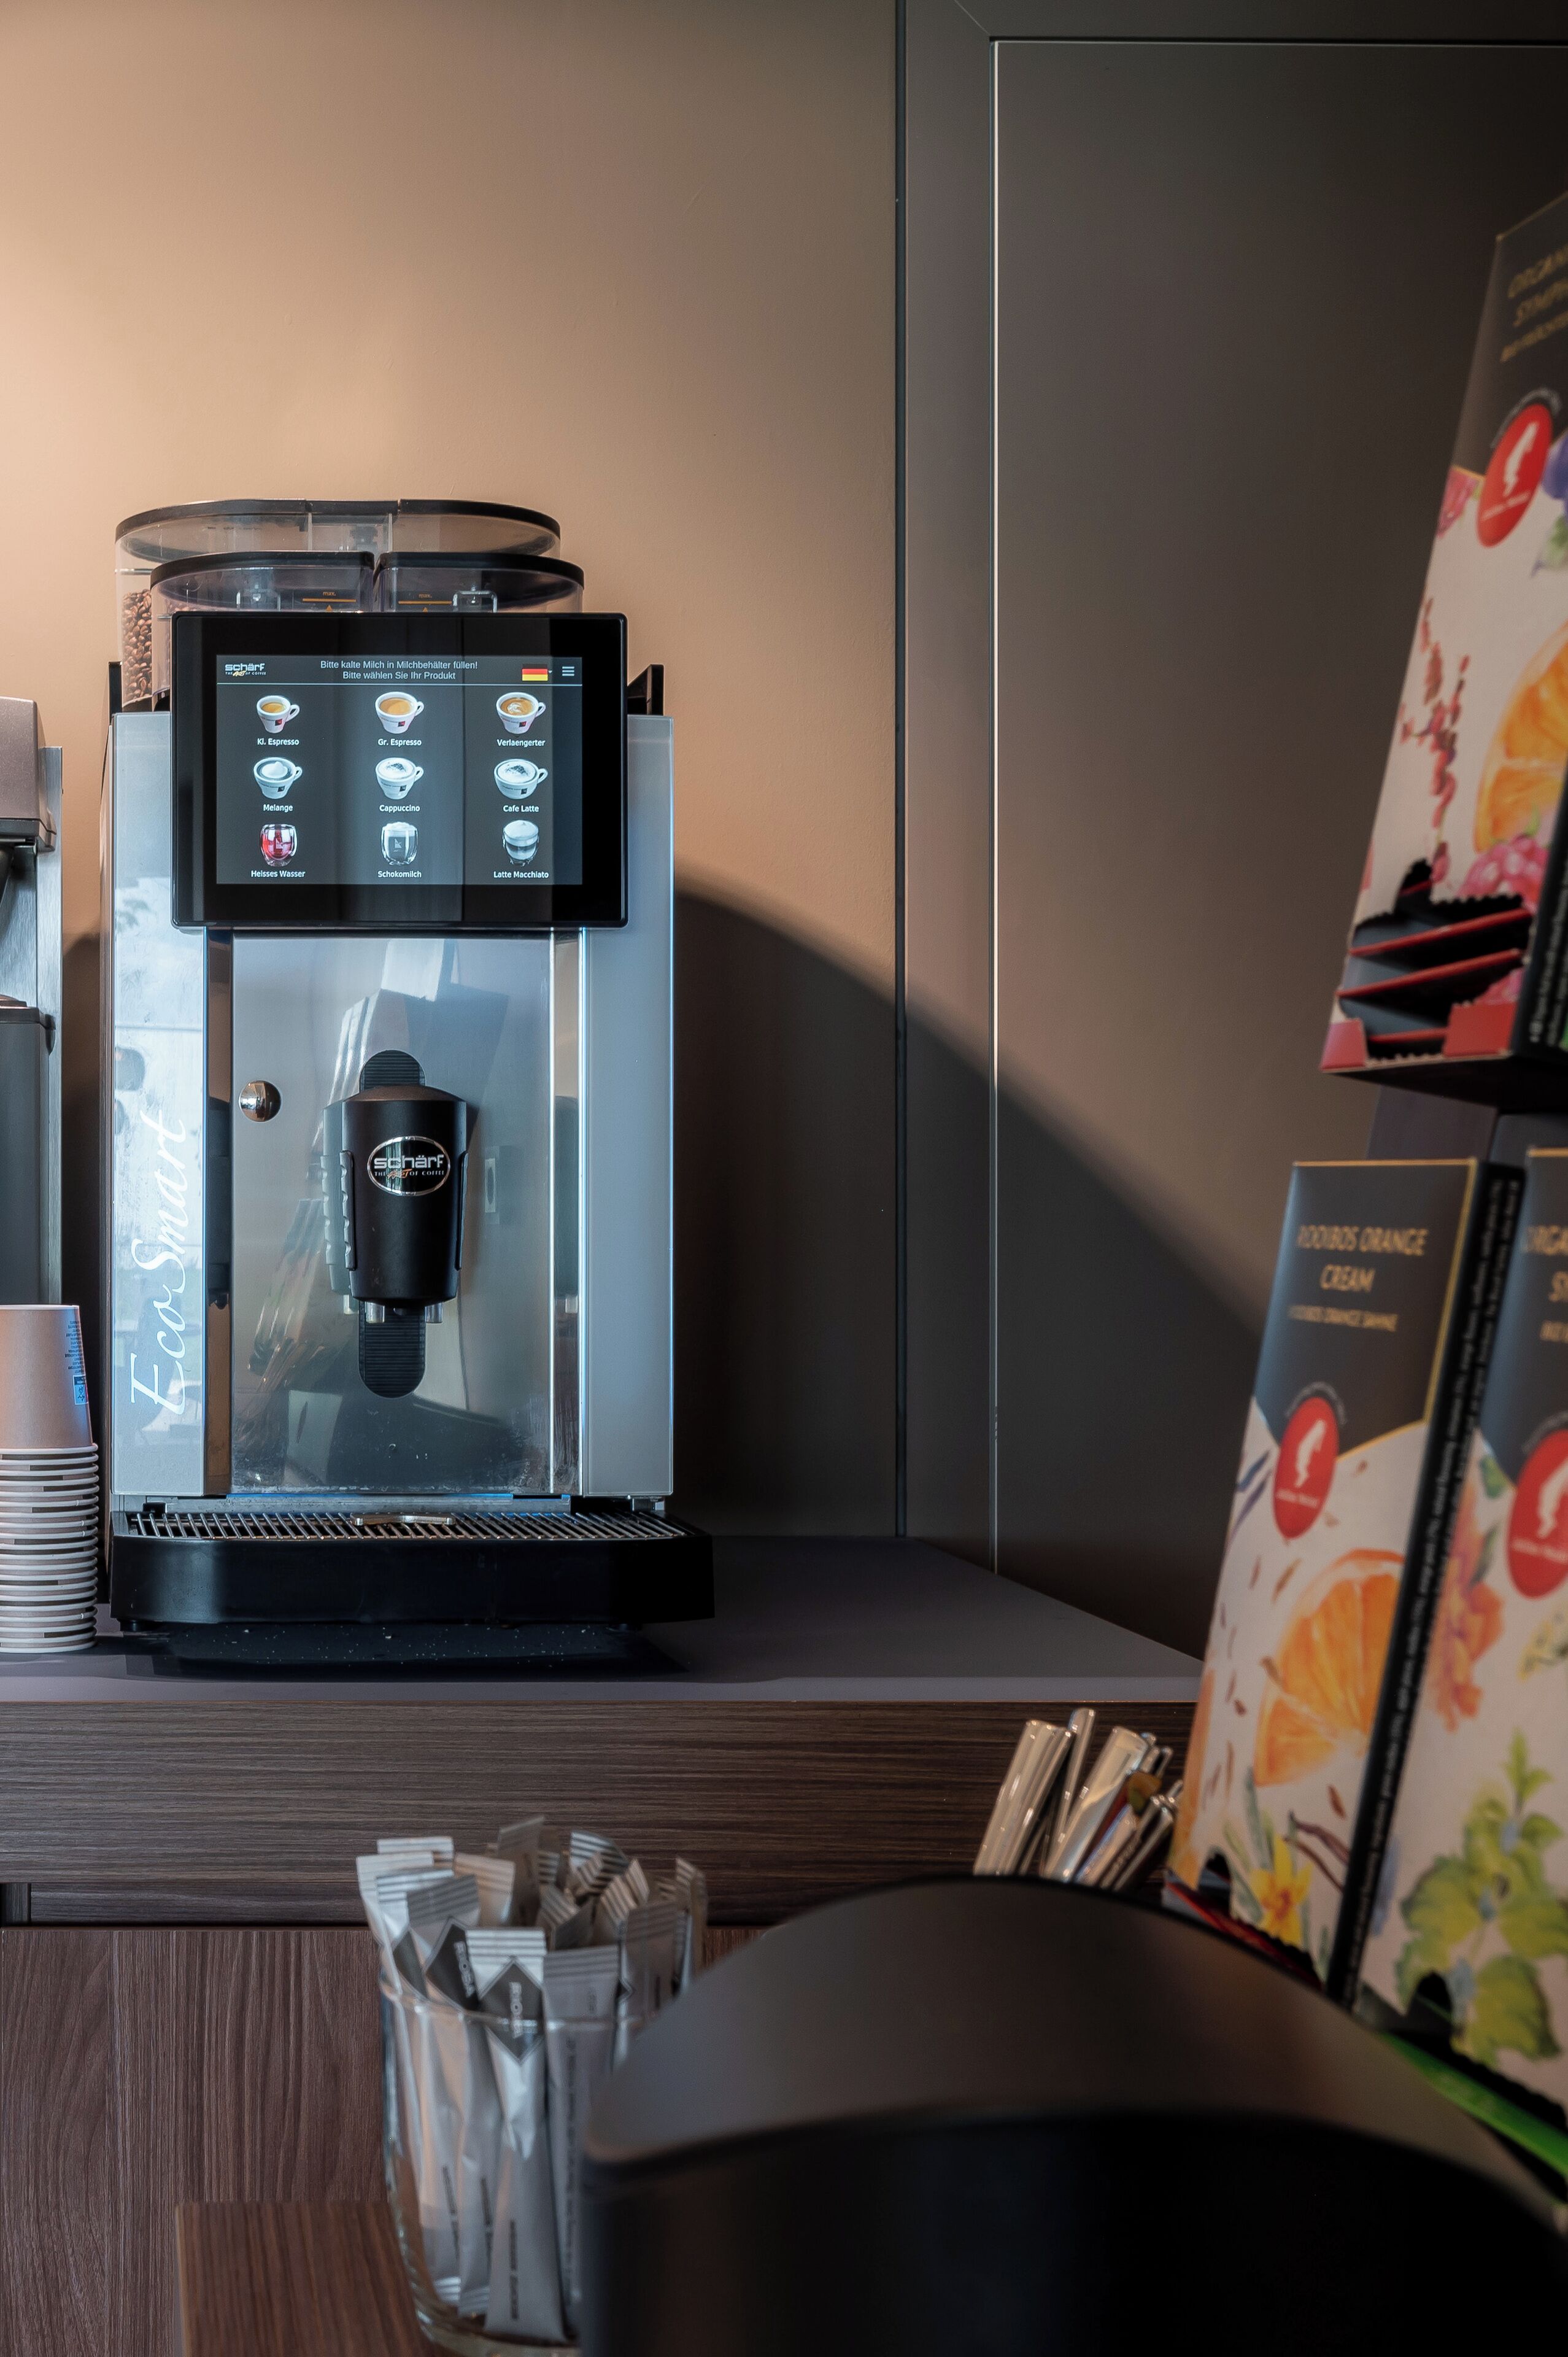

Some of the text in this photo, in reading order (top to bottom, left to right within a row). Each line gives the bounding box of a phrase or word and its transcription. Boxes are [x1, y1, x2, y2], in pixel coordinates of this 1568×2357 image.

[320, 660, 339, 668] Bitte
[341, 660, 361, 668] kalte
[363, 660, 385, 668] Milch
[396, 660, 451, 669] Milchbehälter
[453, 660, 478, 669] füllen!
[342, 671, 456, 679] Bitte wählen Sie Ihr Produkt
[268, 738, 300, 747] Espresso
[390, 738, 422, 748] Espresso
[496, 739, 546, 748] Verlaengerter
[263, 803, 294, 813] Melange
[379, 804, 421, 813] Cappuccino
[374, 1155, 444, 1169] schärf
[1359, 1226, 1429, 1257] ORANGE
[1319, 1263, 1377, 1293] CREAM
